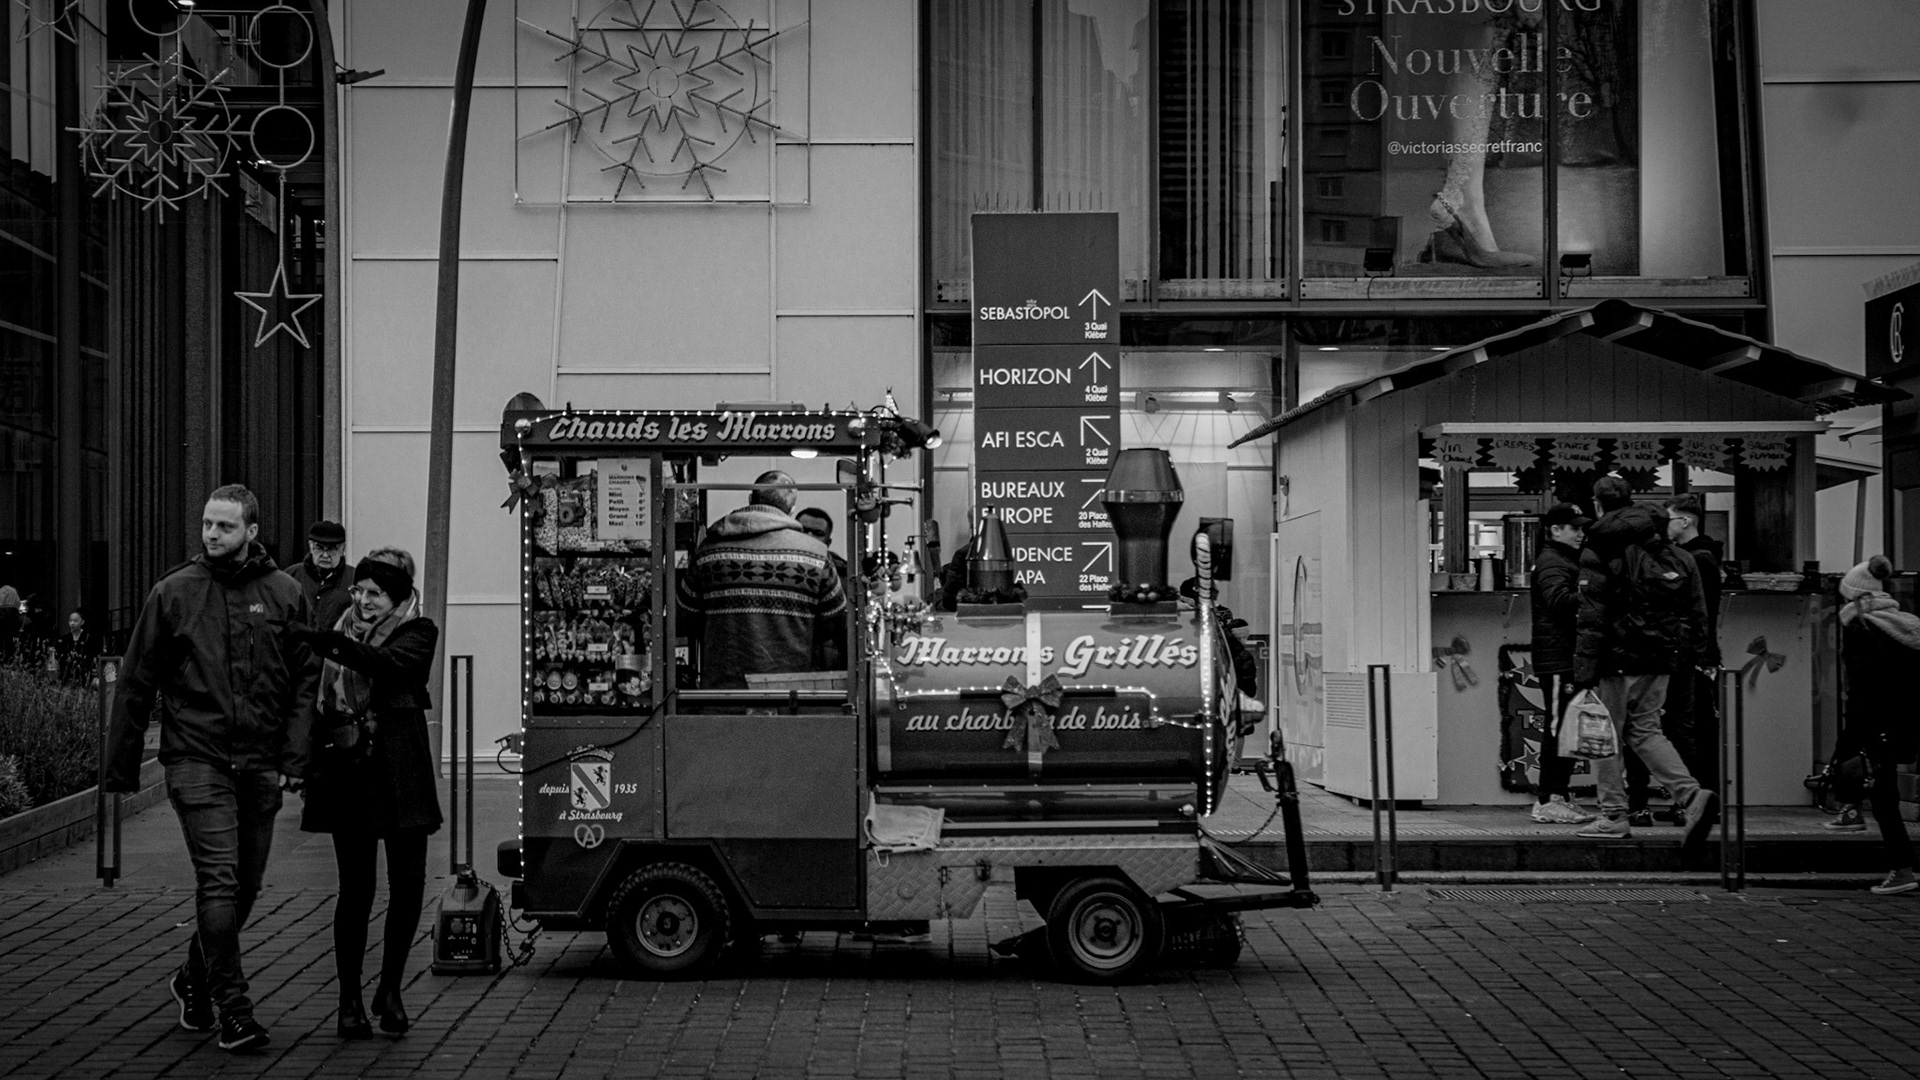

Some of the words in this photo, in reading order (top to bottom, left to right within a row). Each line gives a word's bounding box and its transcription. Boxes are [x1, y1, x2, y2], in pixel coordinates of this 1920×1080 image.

[1338, 0, 1601, 15] STRASBOUG
[1366, 33, 1572, 74] Nouvelle
[980, 306, 1070, 320] SEBASTOPOL
[1085, 322, 1089, 330] 3
[1090, 322, 1107, 330] Quai
[1085, 331, 1107, 339] Kléber
[980, 368, 1071, 385] HORIZON
[1085, 394, 1108, 402] Kléber
[549, 416, 660, 441] Chauds
[668, 416, 708, 441] les
[716, 413, 836, 441] Marrons
[982, 432, 1009, 448] AFI
[1016, 431, 1064, 448] ESCA
[1086, 449, 1091, 457] 2
[1092, 449, 1108, 457] Quai
[1086, 457, 1108, 465] Kléber
[981, 482, 1065, 498] BUREAUX
[1078, 512, 1087, 520] 20
[1089, 512, 1108, 520] Place
[1079, 575, 1088, 583] 22
[1089, 575, 1108, 583] Place
[1079, 583, 1092, 591] des
[896, 635, 1054, 666] Marrons
[1058, 634, 1198, 677] Grillés
[905, 712, 940, 731] au
[944, 707, 1056, 731] charb
[1057, 707, 1086, 731] de
[1092, 706, 1141, 731] bois
[539, 783, 570, 796] depuis
[614, 783, 637, 794] 1935
[559, 810, 566, 820] à
[568, 810, 623, 822] Strasbourg
